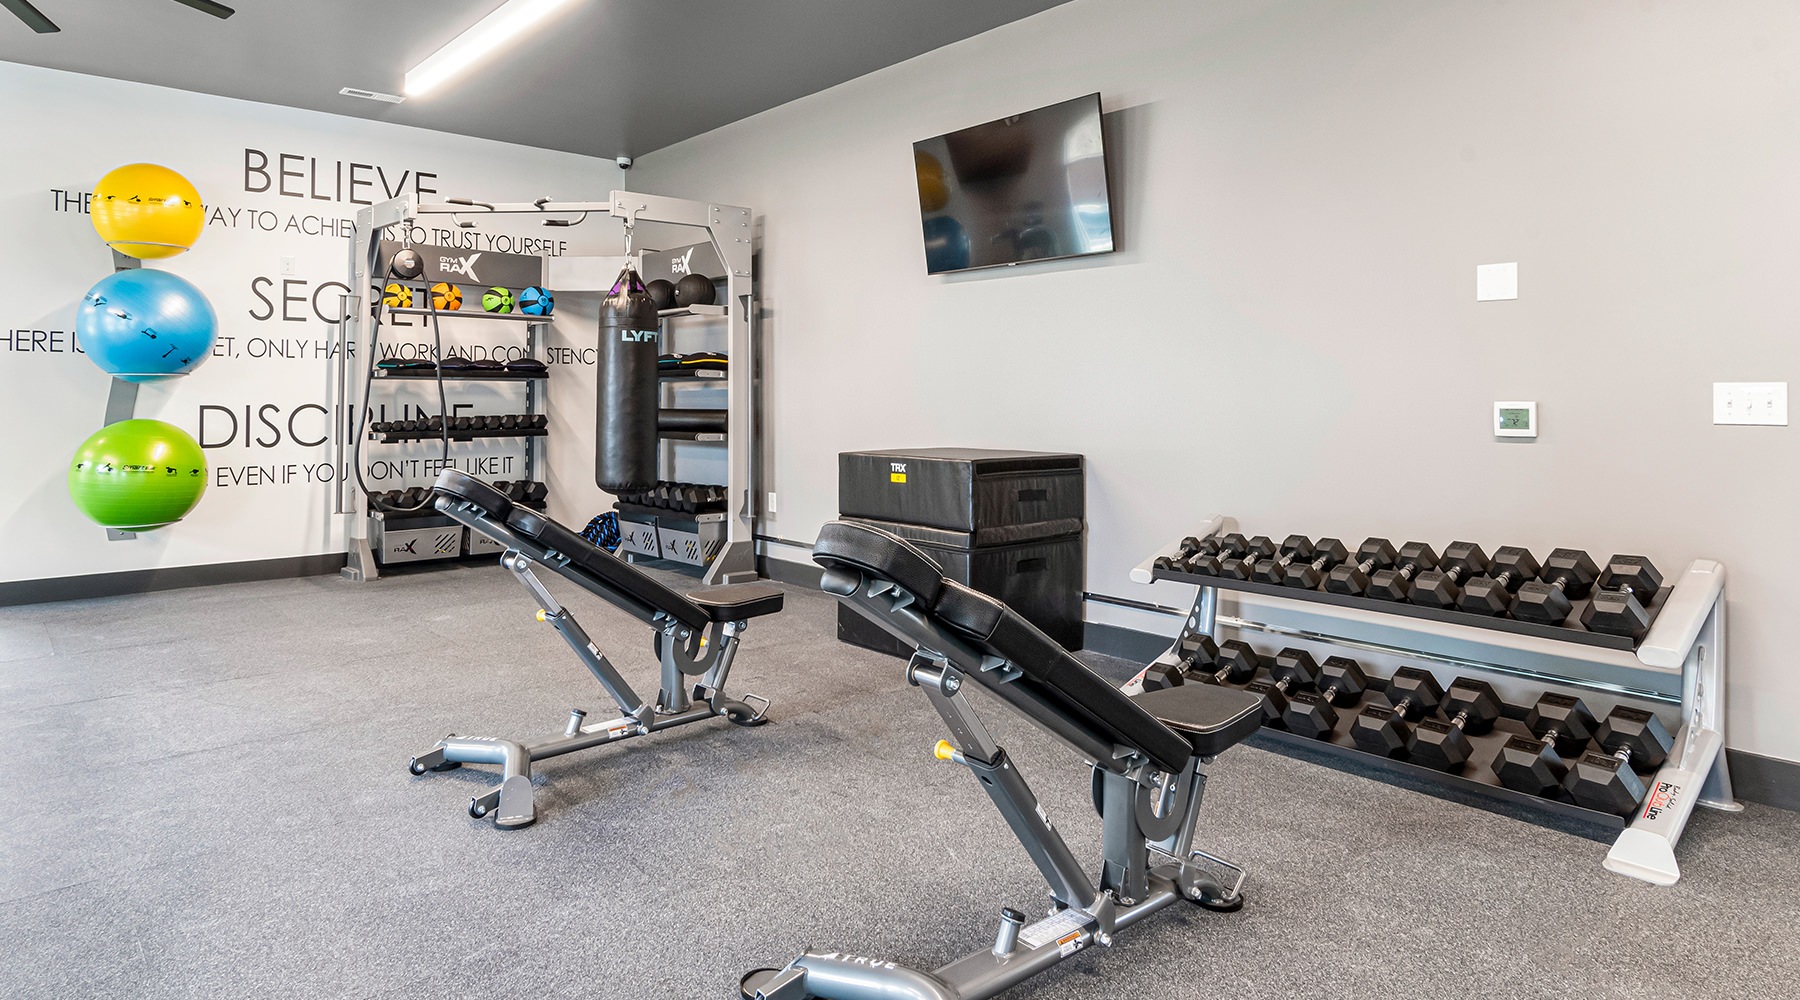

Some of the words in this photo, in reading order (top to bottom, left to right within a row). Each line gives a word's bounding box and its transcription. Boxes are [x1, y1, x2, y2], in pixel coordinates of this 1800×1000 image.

[243, 148, 438, 205] BELIEVE
[50, 188, 92, 214] THE
[204, 205, 242, 228] AY
[247, 209, 279, 232] TO
[284, 214, 357, 239] ACHIE
[431, 228, 481, 250] TRUST
[485, 233, 567, 257] YOURSELF
[247, 337, 308, 359] ONLY
[315, 340, 357, 361] HAR
[379, 342, 437, 362] WORK
[446, 345, 487, 362] AND
[216, 464, 275, 487] EVEN
[282, 464, 297, 484] IF
[366, 460, 419, 480] ON'T
[466, 457, 499, 475] LIKE
[502, 456, 514, 474] IT
[890, 462, 907, 473] TRX
